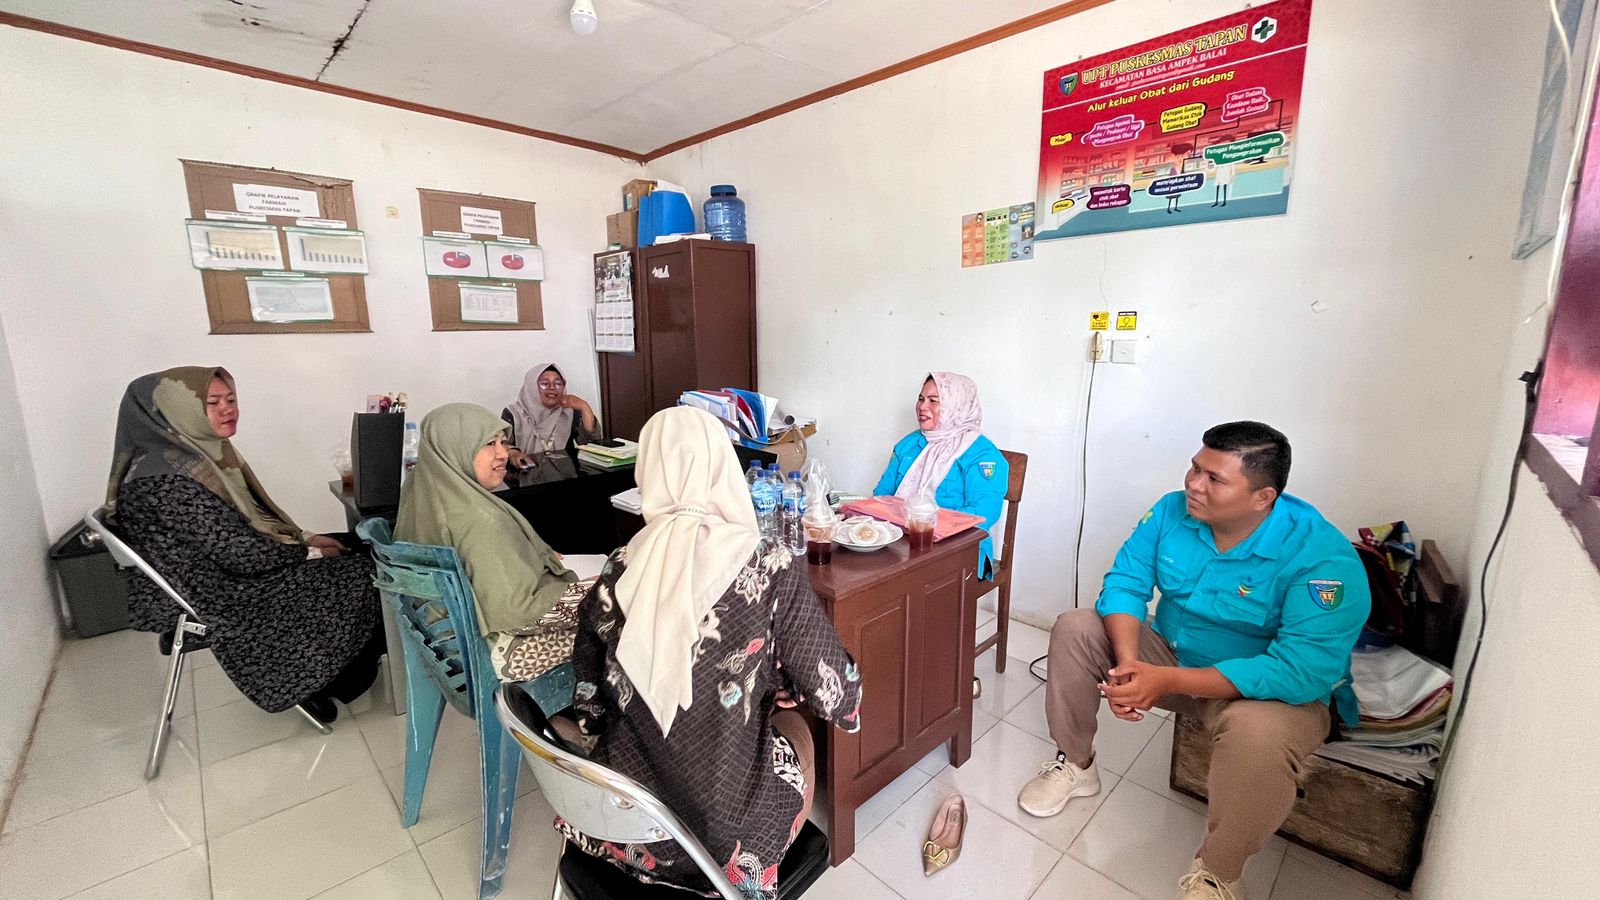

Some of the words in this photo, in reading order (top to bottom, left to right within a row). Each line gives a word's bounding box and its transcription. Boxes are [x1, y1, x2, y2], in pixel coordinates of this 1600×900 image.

[1082, 64, 1109, 84] UPT
[1110, 40, 1193, 77] PUSKESMAS
[1195, 24, 1248, 53] TAPAN
[1100, 70, 1145, 88] KECAMATAN
[1146, 64, 1167, 76] BASA
[1168, 55, 1198, 70] AMPEK
[1200, 48, 1227, 61] BALAI
[1087, 102, 1107, 113] Alur
[1109, 95, 1137, 108] keluar
[1140, 86, 1166, 99] Obat
[1169, 80, 1190, 93] dari
[1192, 71, 1235, 87] Gudang
